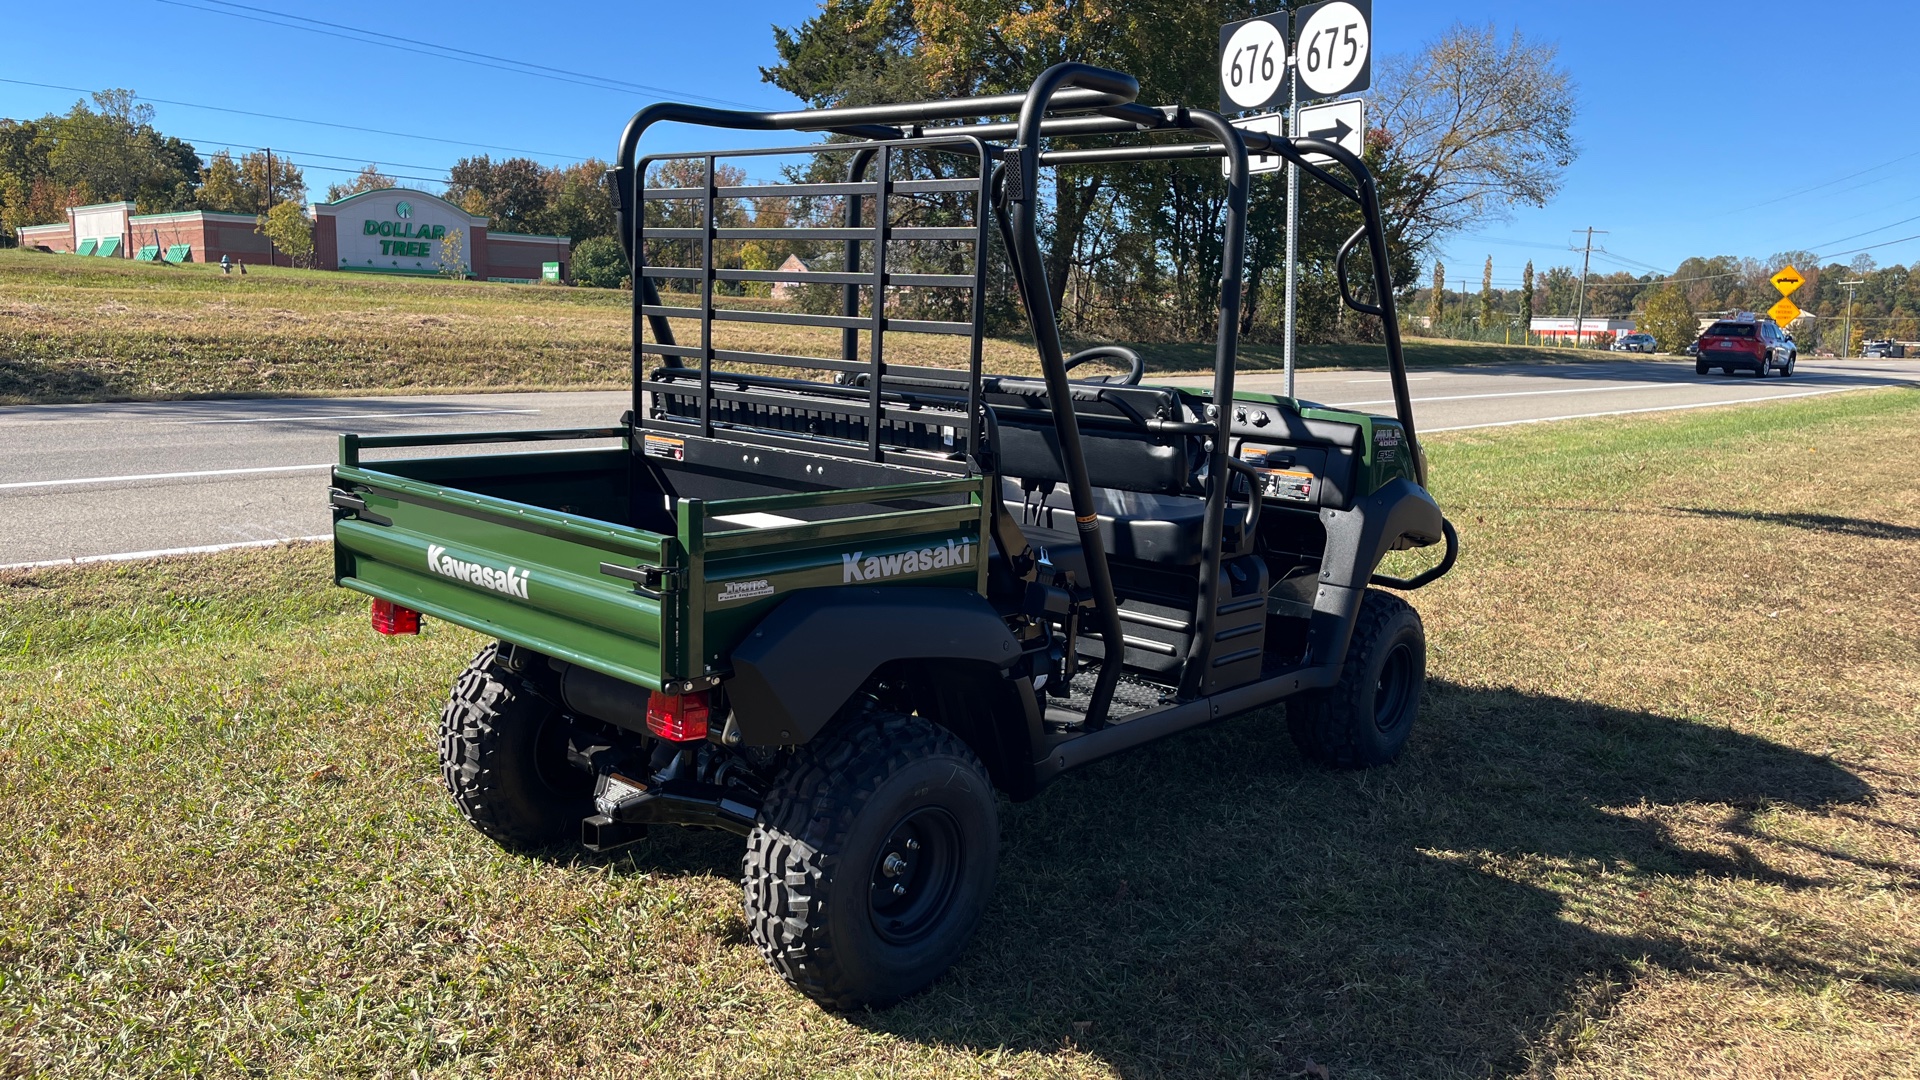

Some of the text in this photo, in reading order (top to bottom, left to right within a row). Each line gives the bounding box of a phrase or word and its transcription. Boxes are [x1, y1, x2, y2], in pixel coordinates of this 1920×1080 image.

[1230, 40, 1274, 87] 676
[1307, 23, 1358, 72] 675
[363, 219, 446, 240] DOLLAR
[379, 239, 431, 257] TREE
[427, 544, 531, 600] Kawasaki
[842, 536, 970, 583] Kawasaki
[724, 579, 769, 595] Trans
